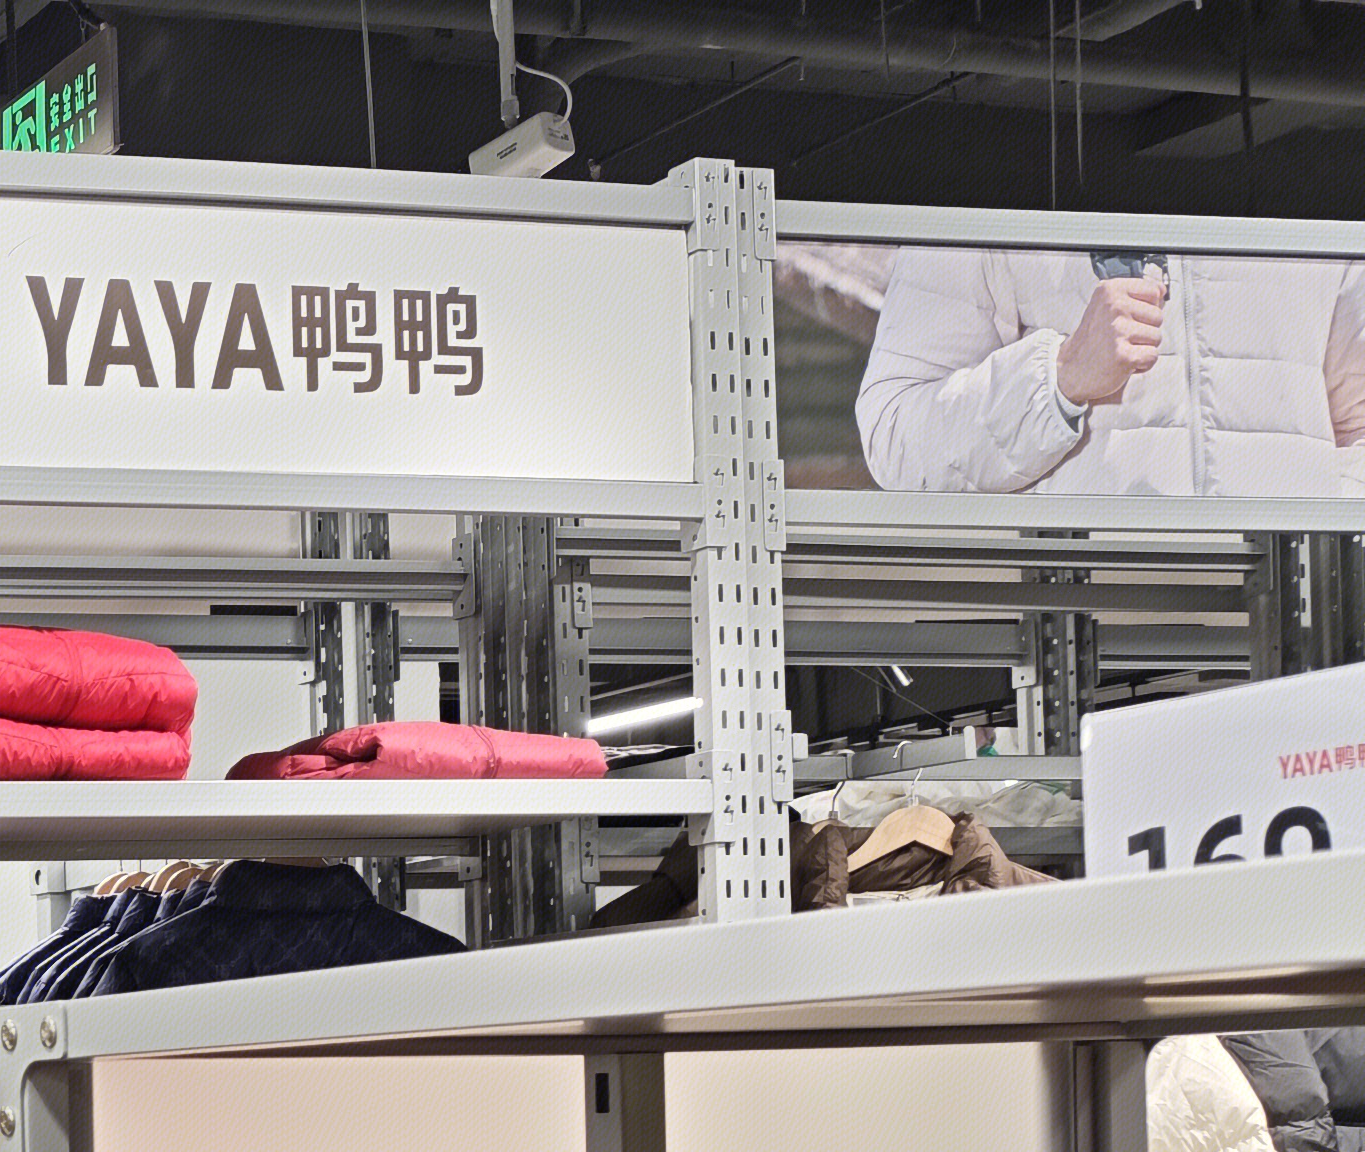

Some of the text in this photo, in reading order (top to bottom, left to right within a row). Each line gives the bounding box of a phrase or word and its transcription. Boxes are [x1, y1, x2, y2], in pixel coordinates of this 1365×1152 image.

[50, 63, 97, 132] 安全出口
[50, 108, 98, 154] EXIT
[25, 275, 484, 396] YAYA鸭鸭
